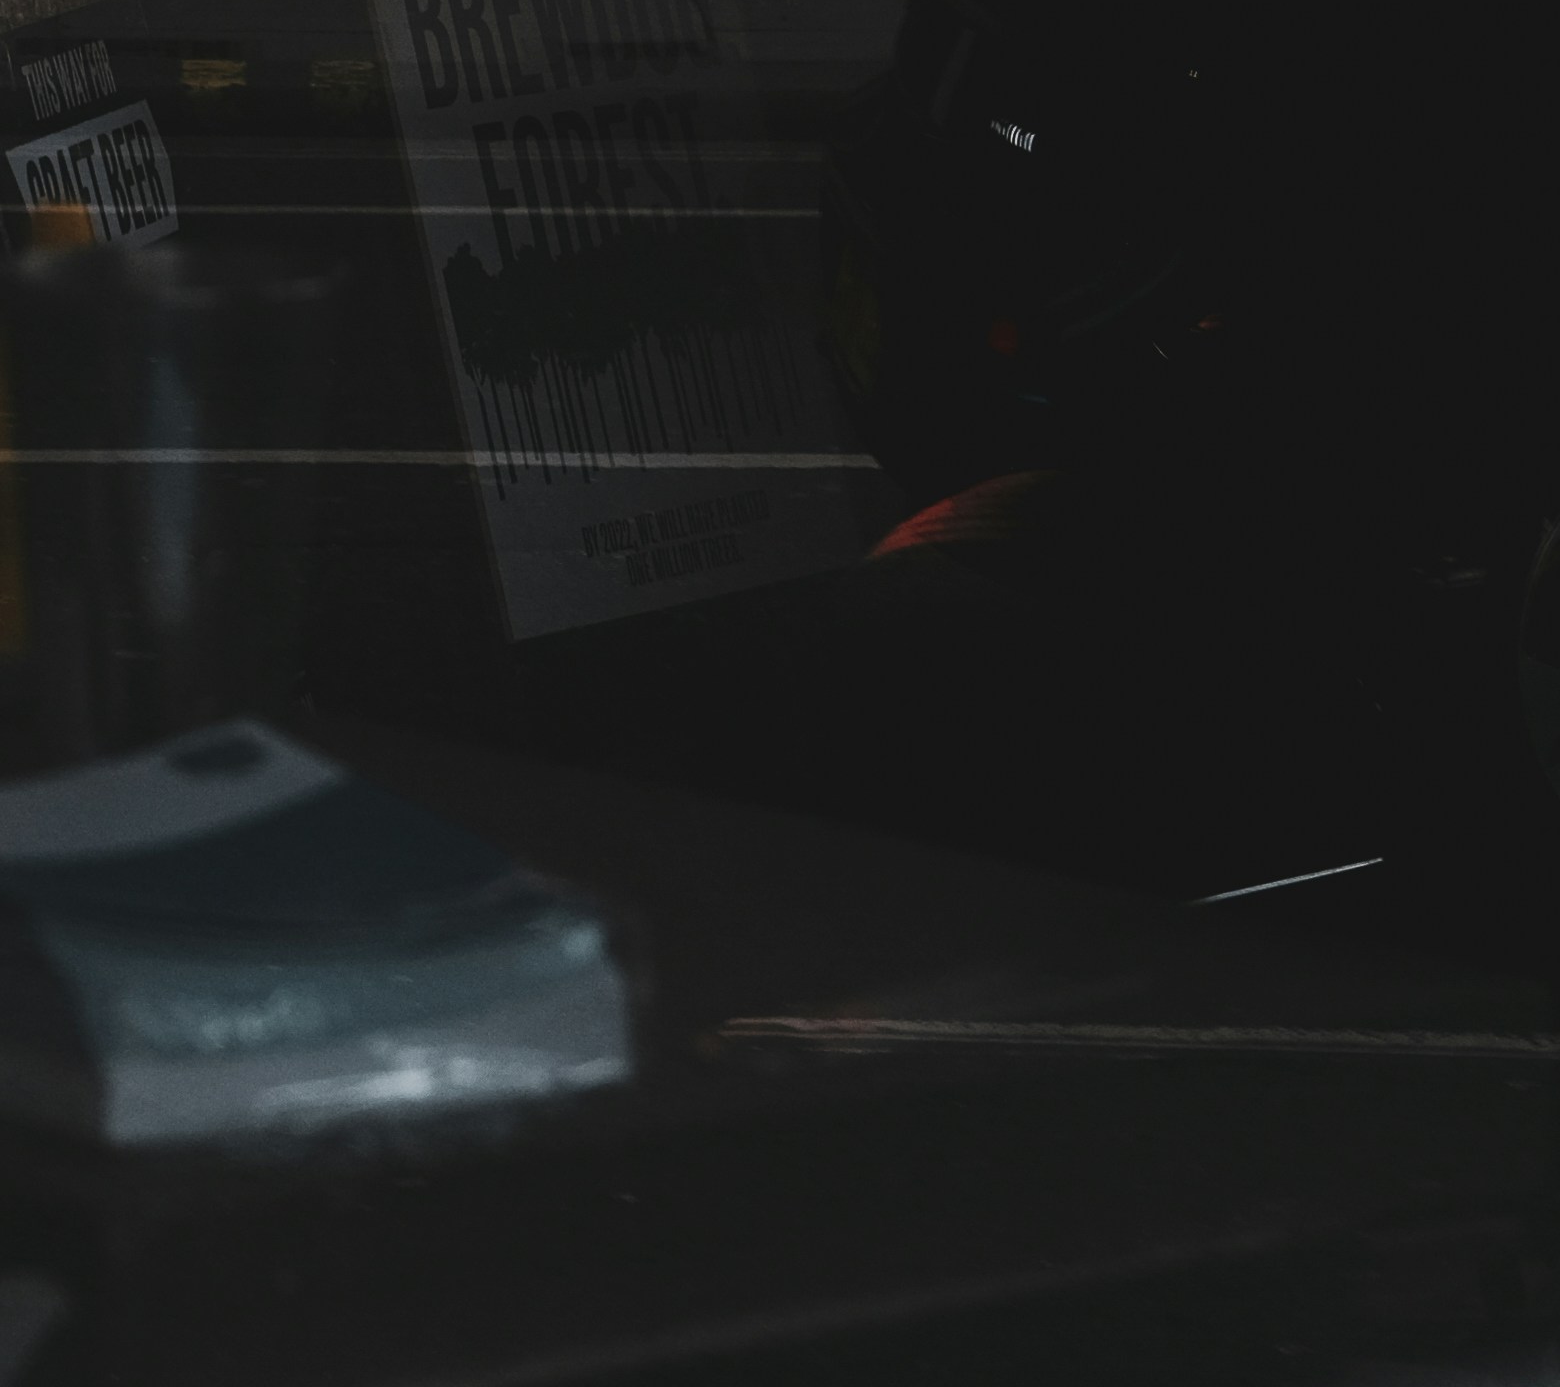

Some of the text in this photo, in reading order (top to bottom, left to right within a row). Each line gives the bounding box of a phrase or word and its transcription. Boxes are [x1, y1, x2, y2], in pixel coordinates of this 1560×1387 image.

[21, 39, 119, 122] THIS WAY FOR
[26, 119, 171, 242] CRAFT BEER
